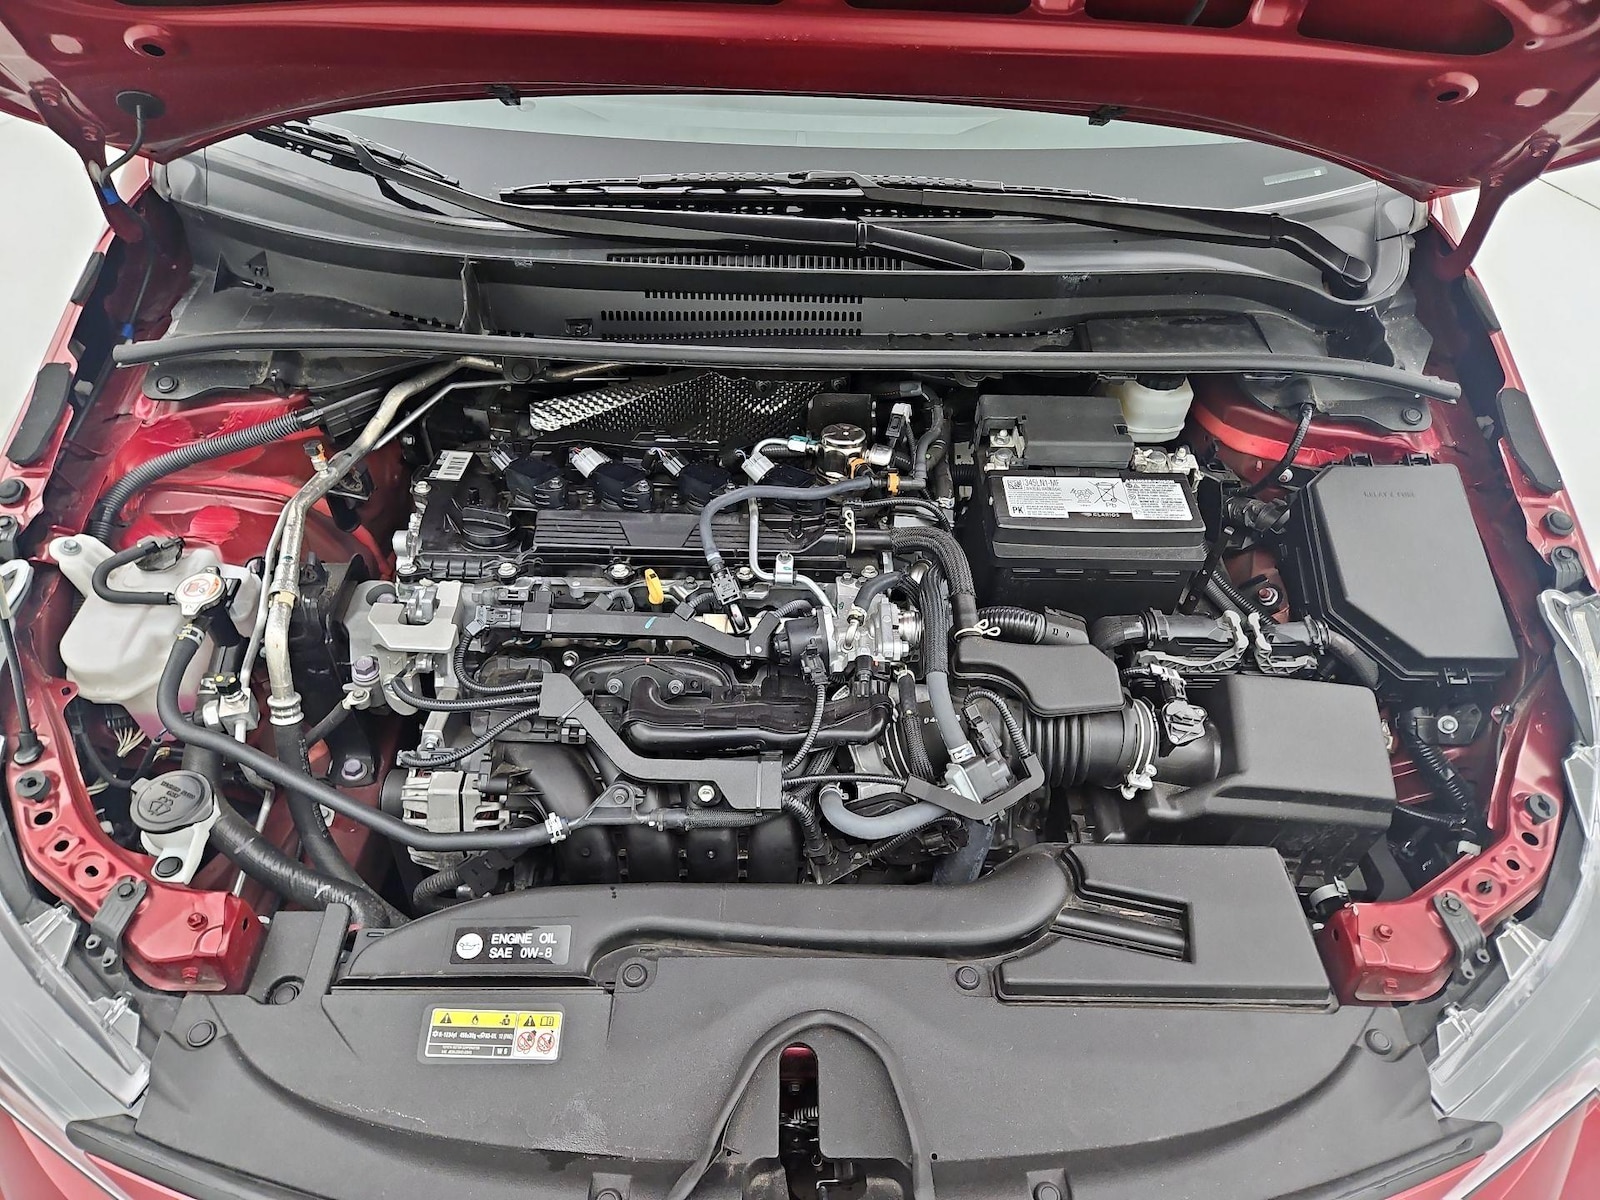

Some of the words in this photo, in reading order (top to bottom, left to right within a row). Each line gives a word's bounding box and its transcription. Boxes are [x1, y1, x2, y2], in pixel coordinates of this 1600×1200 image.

[1012, 506, 1025, 515] PK
[491, 933, 532, 944] ENGINE
[539, 933, 557, 944] OIL
[489, 947, 513, 958] SAE
[520, 947, 552, 958] 0W-8
